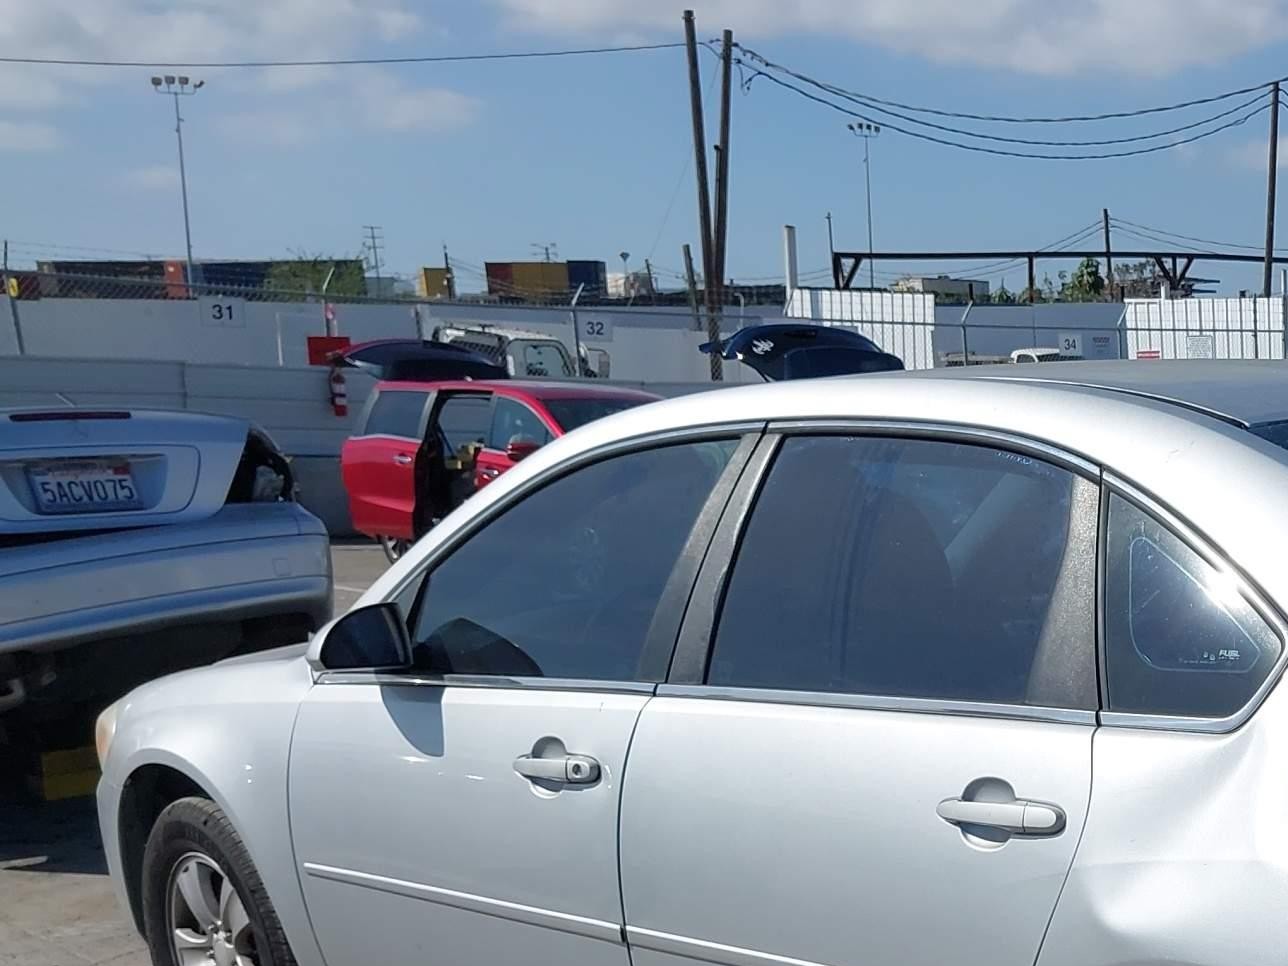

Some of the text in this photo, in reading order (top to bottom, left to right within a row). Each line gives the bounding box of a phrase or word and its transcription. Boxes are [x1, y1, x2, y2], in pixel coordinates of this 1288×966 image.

[211, 304, 233, 320] 31
[586, 321, 604, 336] 32
[1064, 338, 1077, 350] 34
[40, 478, 135, 503] 5ACV075
